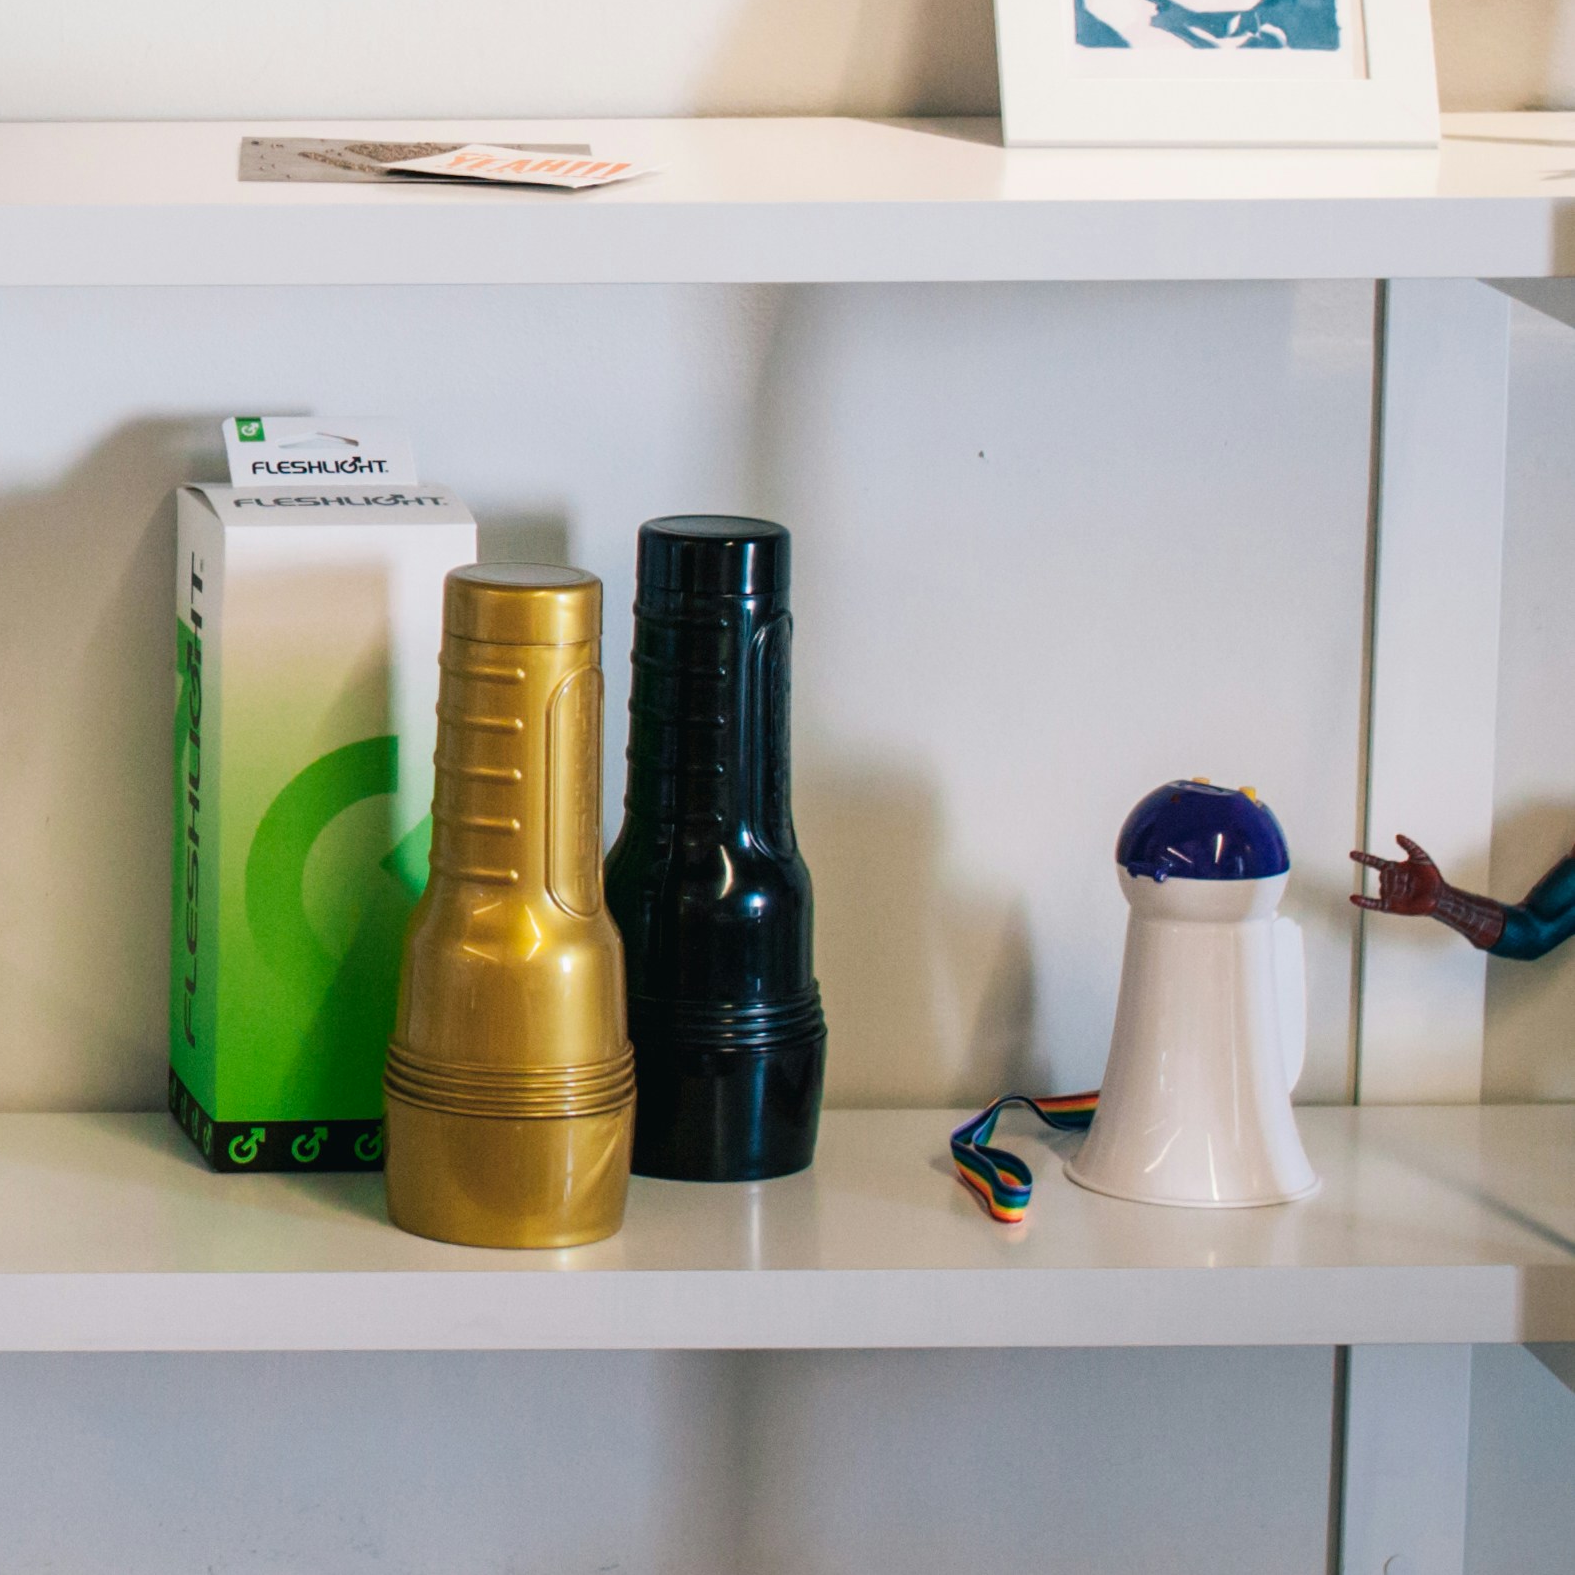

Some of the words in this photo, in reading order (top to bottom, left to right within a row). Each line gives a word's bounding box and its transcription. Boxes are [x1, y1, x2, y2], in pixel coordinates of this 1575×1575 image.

[252, 457, 389, 474] FLESHLIGHT
[234, 494, 445, 507] FLESHLIGHT
[182, 551, 205, 1048] FLESHLIGHT
